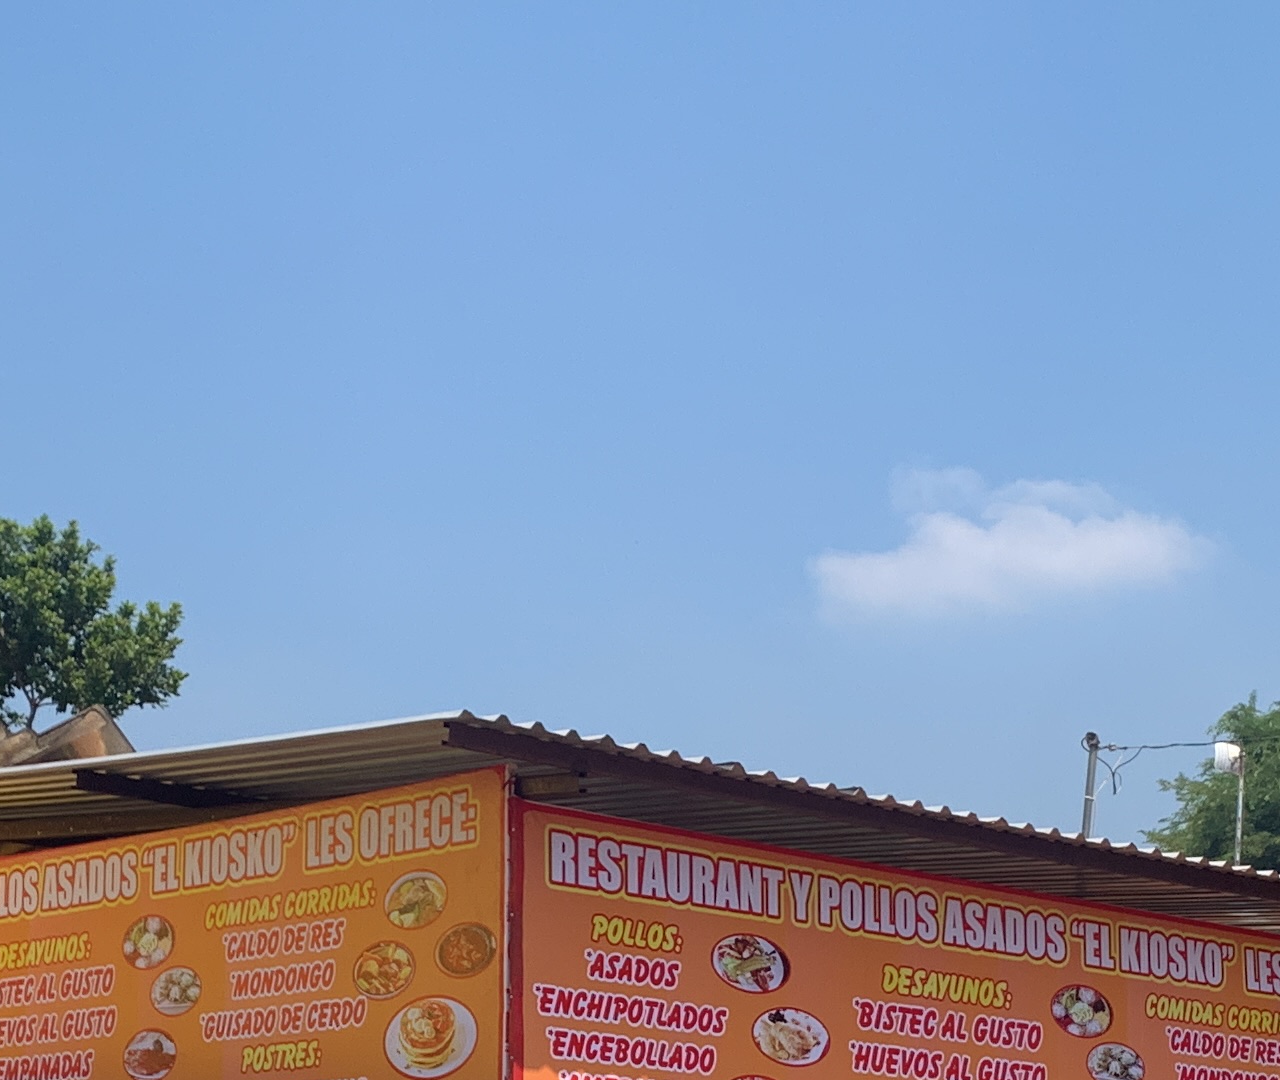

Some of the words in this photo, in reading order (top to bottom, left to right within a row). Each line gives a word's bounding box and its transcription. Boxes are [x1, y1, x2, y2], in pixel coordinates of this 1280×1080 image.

[42, 851, 137, 912] ASADOS
[307, 814, 353, 869] LES
[360, 789, 476, 856] OFRECE:
[205, 894, 278, 929] COMIDAS
[285, 880, 376, 919] CORRIDAS:
[550, 832, 782, 916] RESTAURANT
[789, 871, 812, 921] Y
[820, 875, 938, 942] POLLOS
[944, 899, 1067, 961] ASADOS
[226, 927, 278, 960] CALDO
[284, 926, 304, 952] DE
[311, 921, 344, 949] RES
[592, 915, 682, 952] POLLOS:
[36, 975, 55, 1002] AL
[61, 968, 113, 998] GUSTO
[233, 963, 334, 997] MONDONGO
[590, 954, 680, 987] ASADOS
[882, 966, 1012, 1008] DESAYUNOS:
[39, 1014, 57, 1040] AL
[63, 1007, 116, 1037] GUSTO
[203, 1010, 275, 1039] GUISADO
[281, 1007, 301, 1032] DE
[308, 1001, 365, 1031] CERDO
[539, 988, 726, 1033] ENCHIPOTLADOS
[859, 1002, 937, 1034] BISTEC
[942, 1010, 966, 1040] AL
[974, 1018, 1042, 1050] GUSTO
[1146, 996, 1223, 1025] COMIDAS
[241, 1041, 321, 1072] POSTRES:
[552, 1032, 715, 1072] ENCEBOLLADO
[855, 1046, 941, 1078] HUEVOS
[1171, 1029, 1224, 1057] CALDO
[1228, 1038, 1251, 1059] DE
